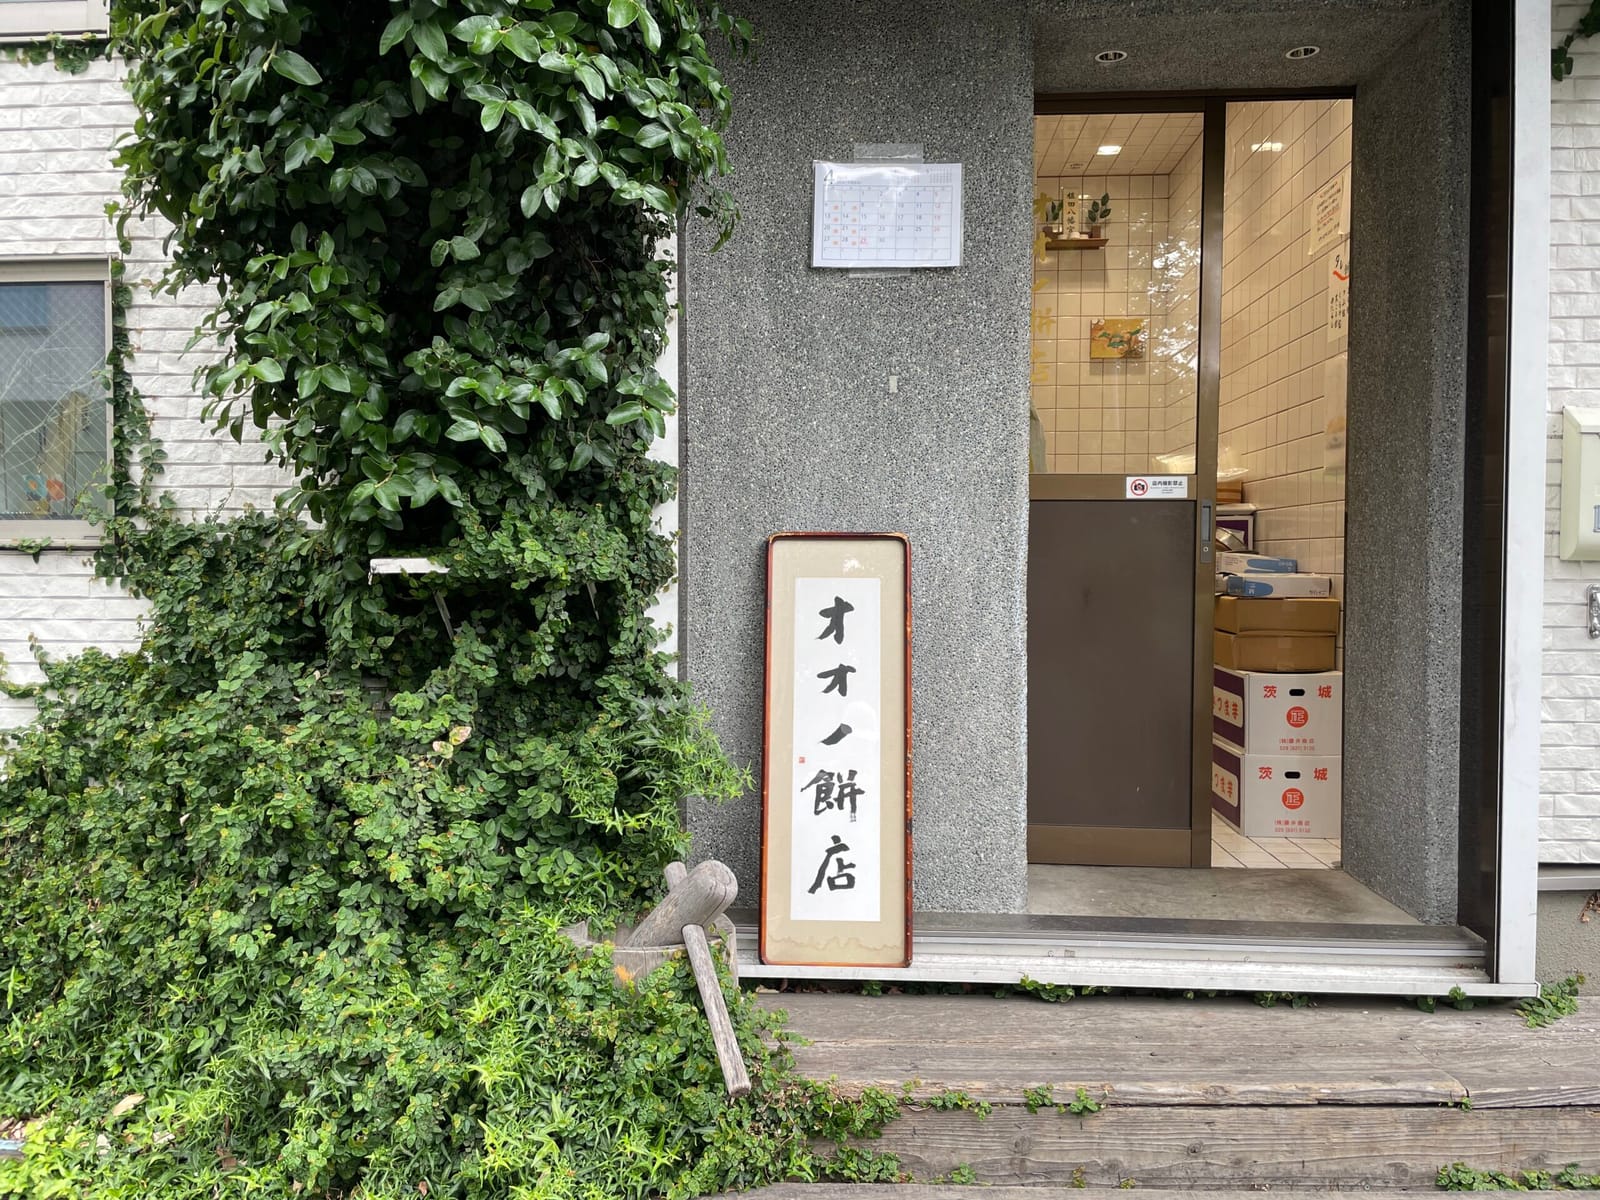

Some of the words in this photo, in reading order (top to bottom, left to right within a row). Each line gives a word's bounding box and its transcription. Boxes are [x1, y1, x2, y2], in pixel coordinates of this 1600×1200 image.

[823, 169, 835, 185] 4
[1263, 685, 1277, 698] 茨
[1318, 685, 1332, 698] 城
[801, 596, 865, 894] オオノ餅店
[1258, 767, 1272, 780] 茨
[1313, 768, 1328, 781] 城
